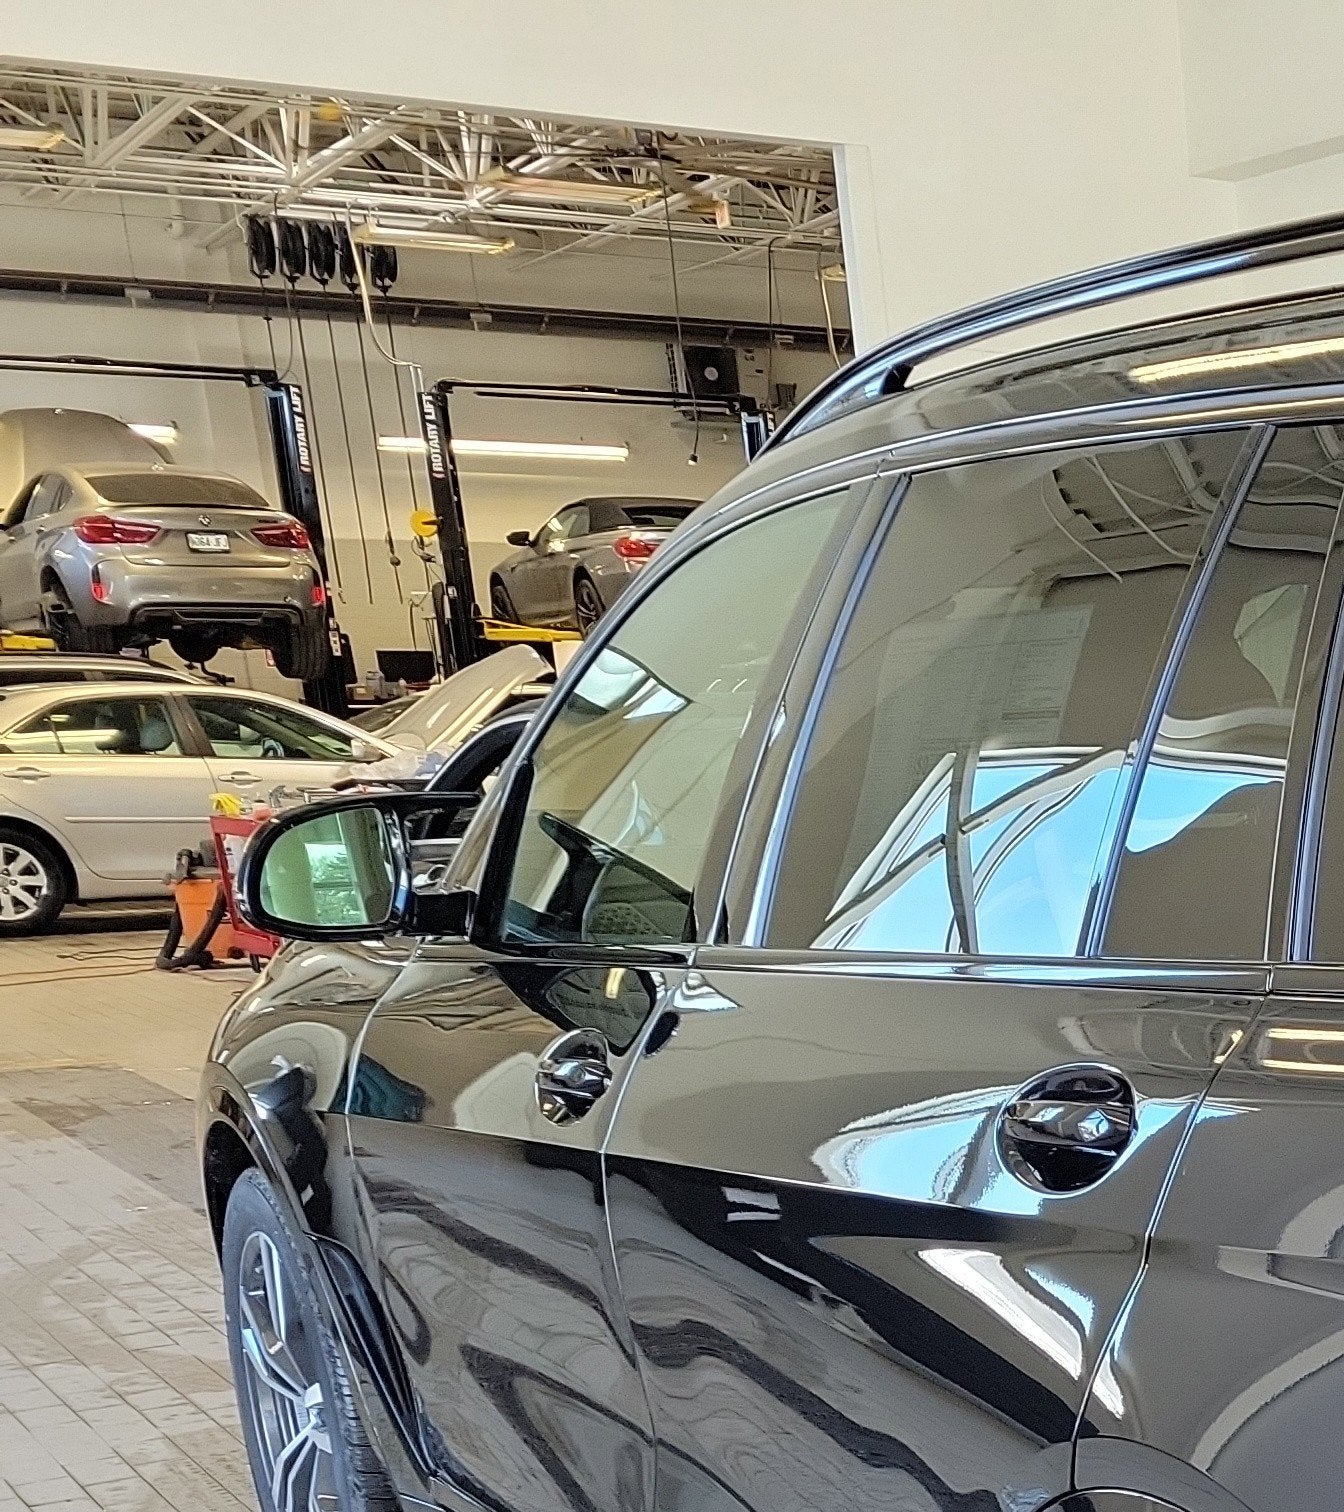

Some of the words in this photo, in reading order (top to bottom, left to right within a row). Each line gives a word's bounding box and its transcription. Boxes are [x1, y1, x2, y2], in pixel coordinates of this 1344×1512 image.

[289, 385, 303, 413] LIFT
[421, 393, 437, 421] LIFT
[294, 414, 311, 466] ROTARY
[425, 421, 445, 472] ROTARY
